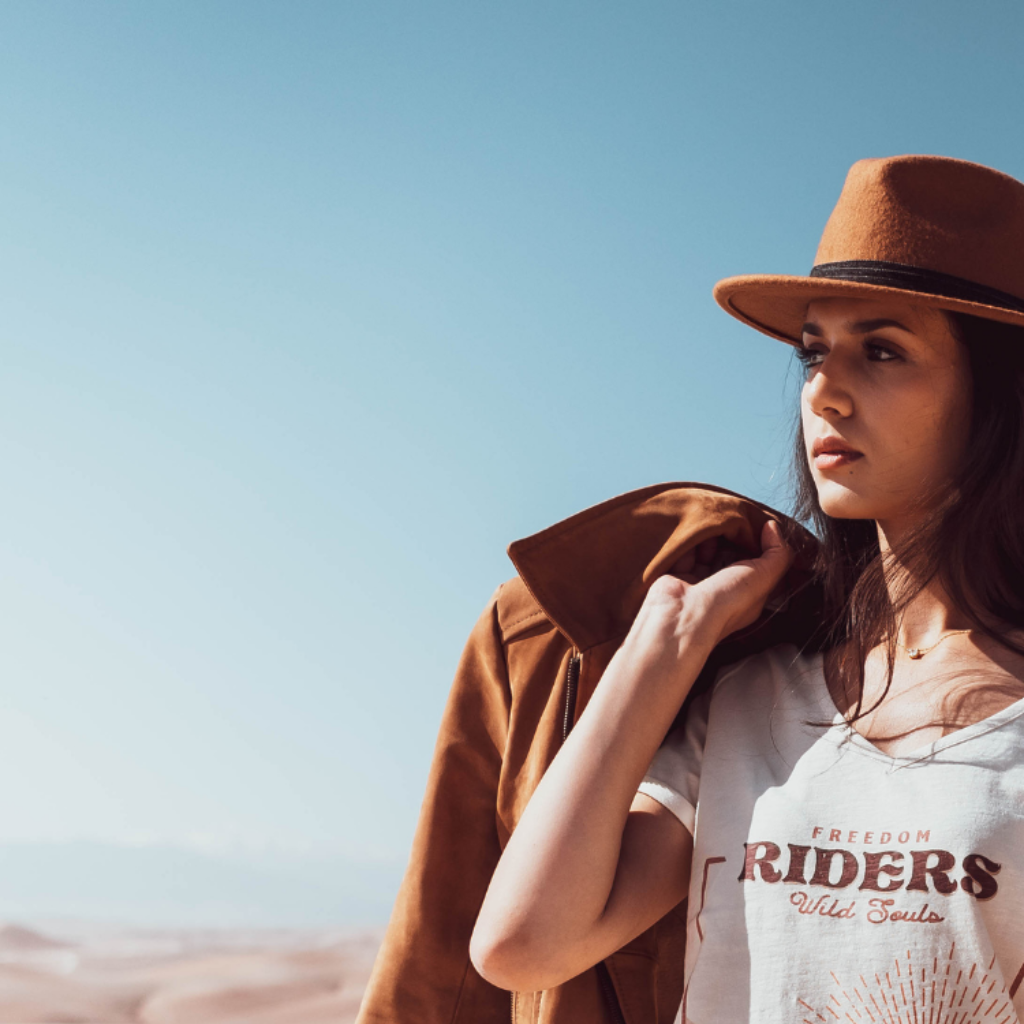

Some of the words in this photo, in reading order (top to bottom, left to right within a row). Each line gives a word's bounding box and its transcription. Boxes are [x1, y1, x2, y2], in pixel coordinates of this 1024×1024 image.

[811, 826, 931, 844] FREEDOM
[738, 841, 1001, 900] RIDERS
[790, 891, 856, 919] Wild
[867, 897, 945, 924] Souls
